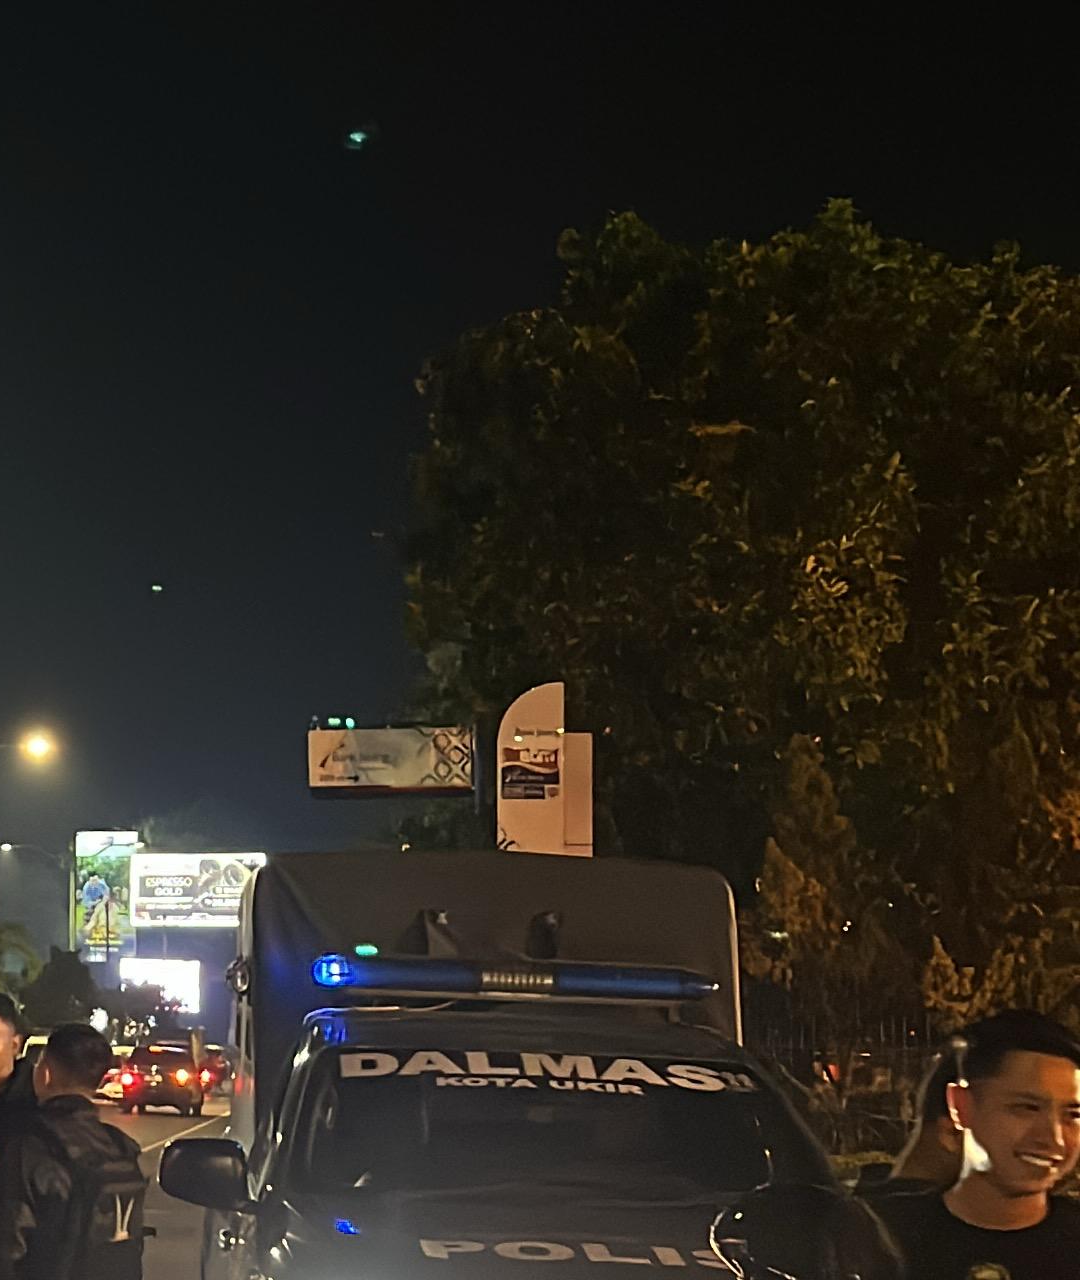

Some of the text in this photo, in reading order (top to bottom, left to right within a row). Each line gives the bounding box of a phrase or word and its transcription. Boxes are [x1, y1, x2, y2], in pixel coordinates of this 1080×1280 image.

[154, 887, 183, 896] GOLD
[339, 1051, 726, 1093] DALMAS
[436, 1077, 645, 1096] KOTA UKIR
